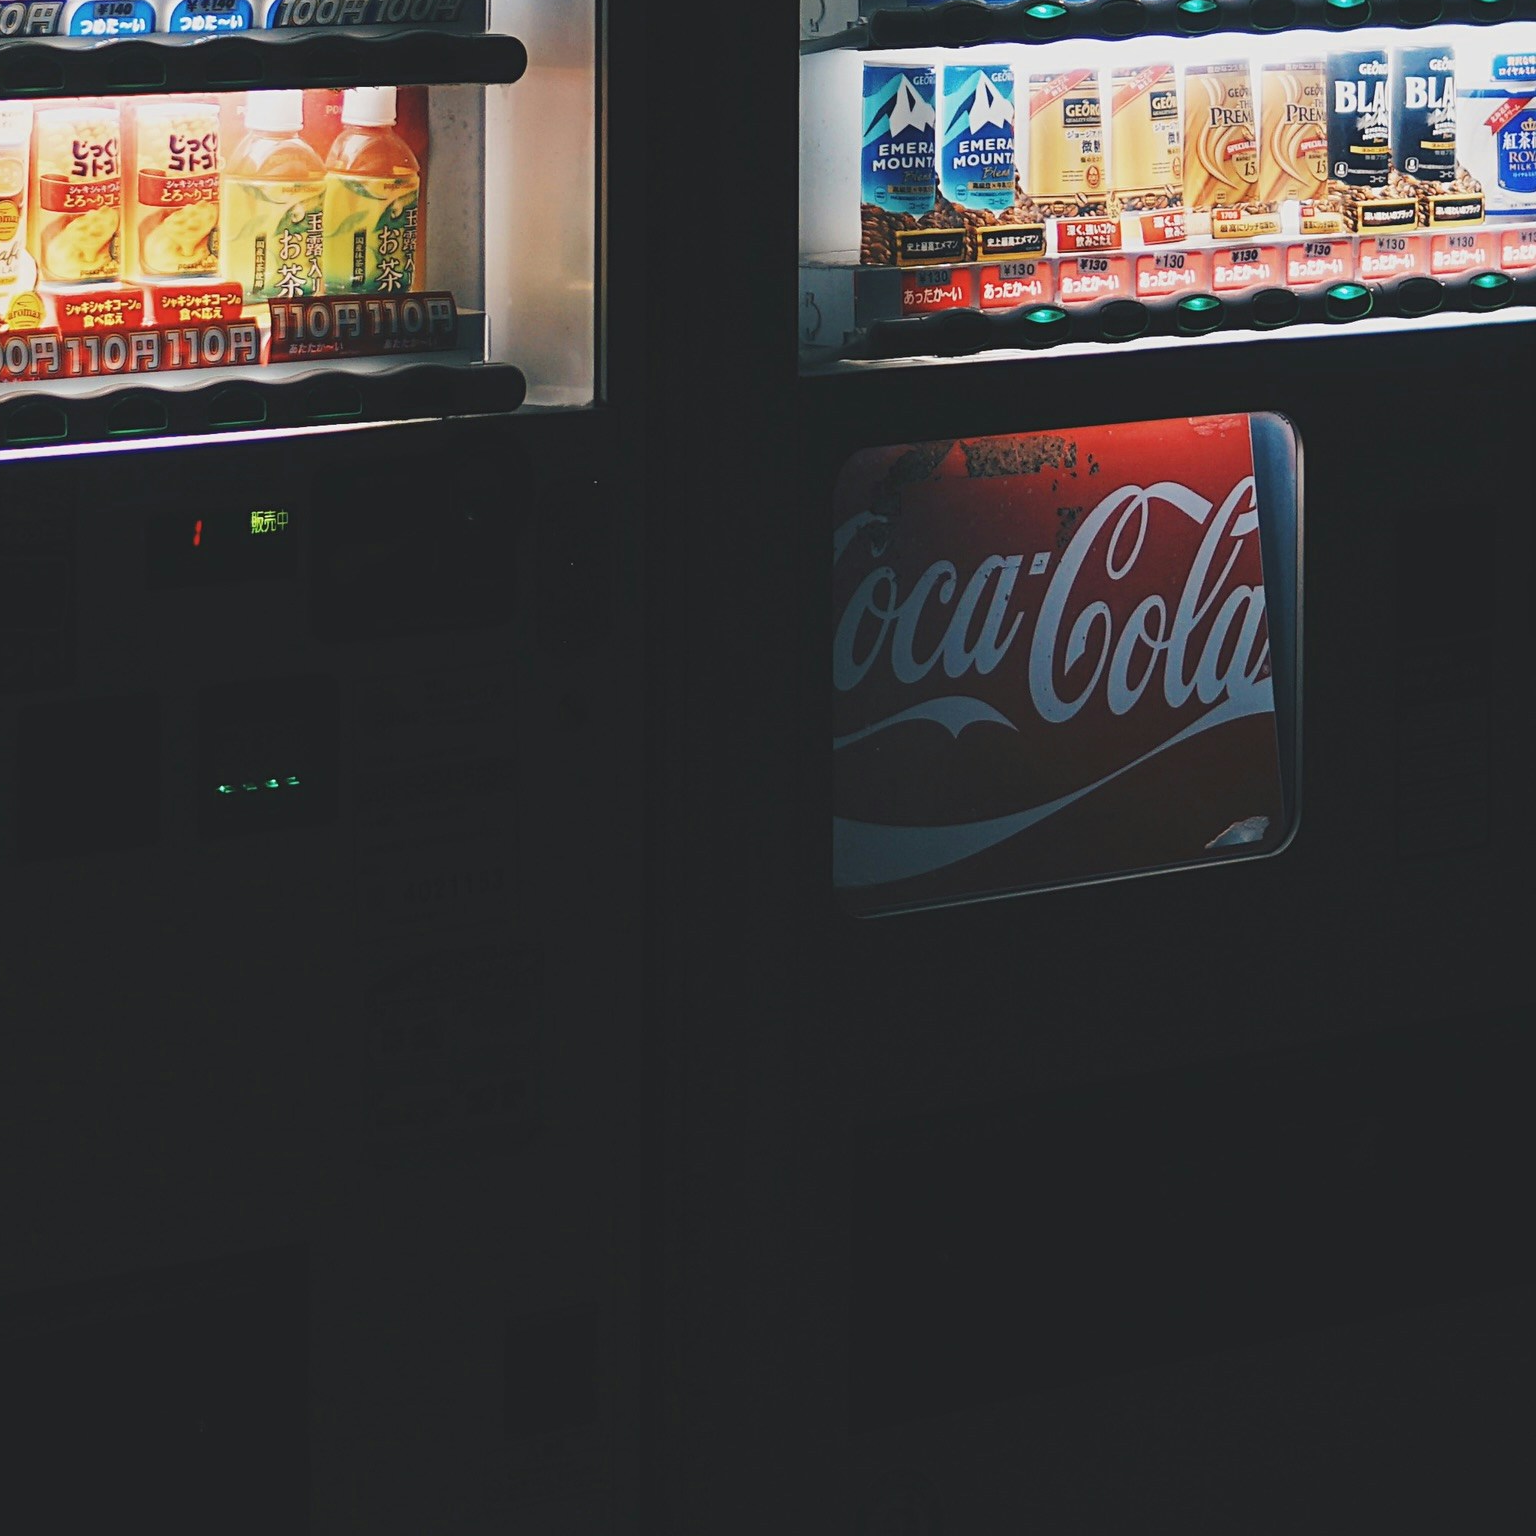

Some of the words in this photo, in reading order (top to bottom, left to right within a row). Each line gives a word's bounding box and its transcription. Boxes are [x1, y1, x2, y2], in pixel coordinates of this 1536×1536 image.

[1509, 163, 1530, 171] MILK
[277, 229, 307, 298] お茶
[377, 225, 402, 292] お茶
[66, 298, 142, 315] シャキシャキコーンの
[162, 292, 241, 308] シャキシャキコーンの
[8, 309, 41, 323] aromax
[82, 314, 125, 329] 食べ応え
[178, 307, 224, 322] 食べ応え
[272, 302, 360, 340] 110円
[369, 297, 455, 337] 110円
[65, 332, 158, 374] 110円
[166, 324, 256, 365] 110円
[251, 509, 288, 534] 販売中
